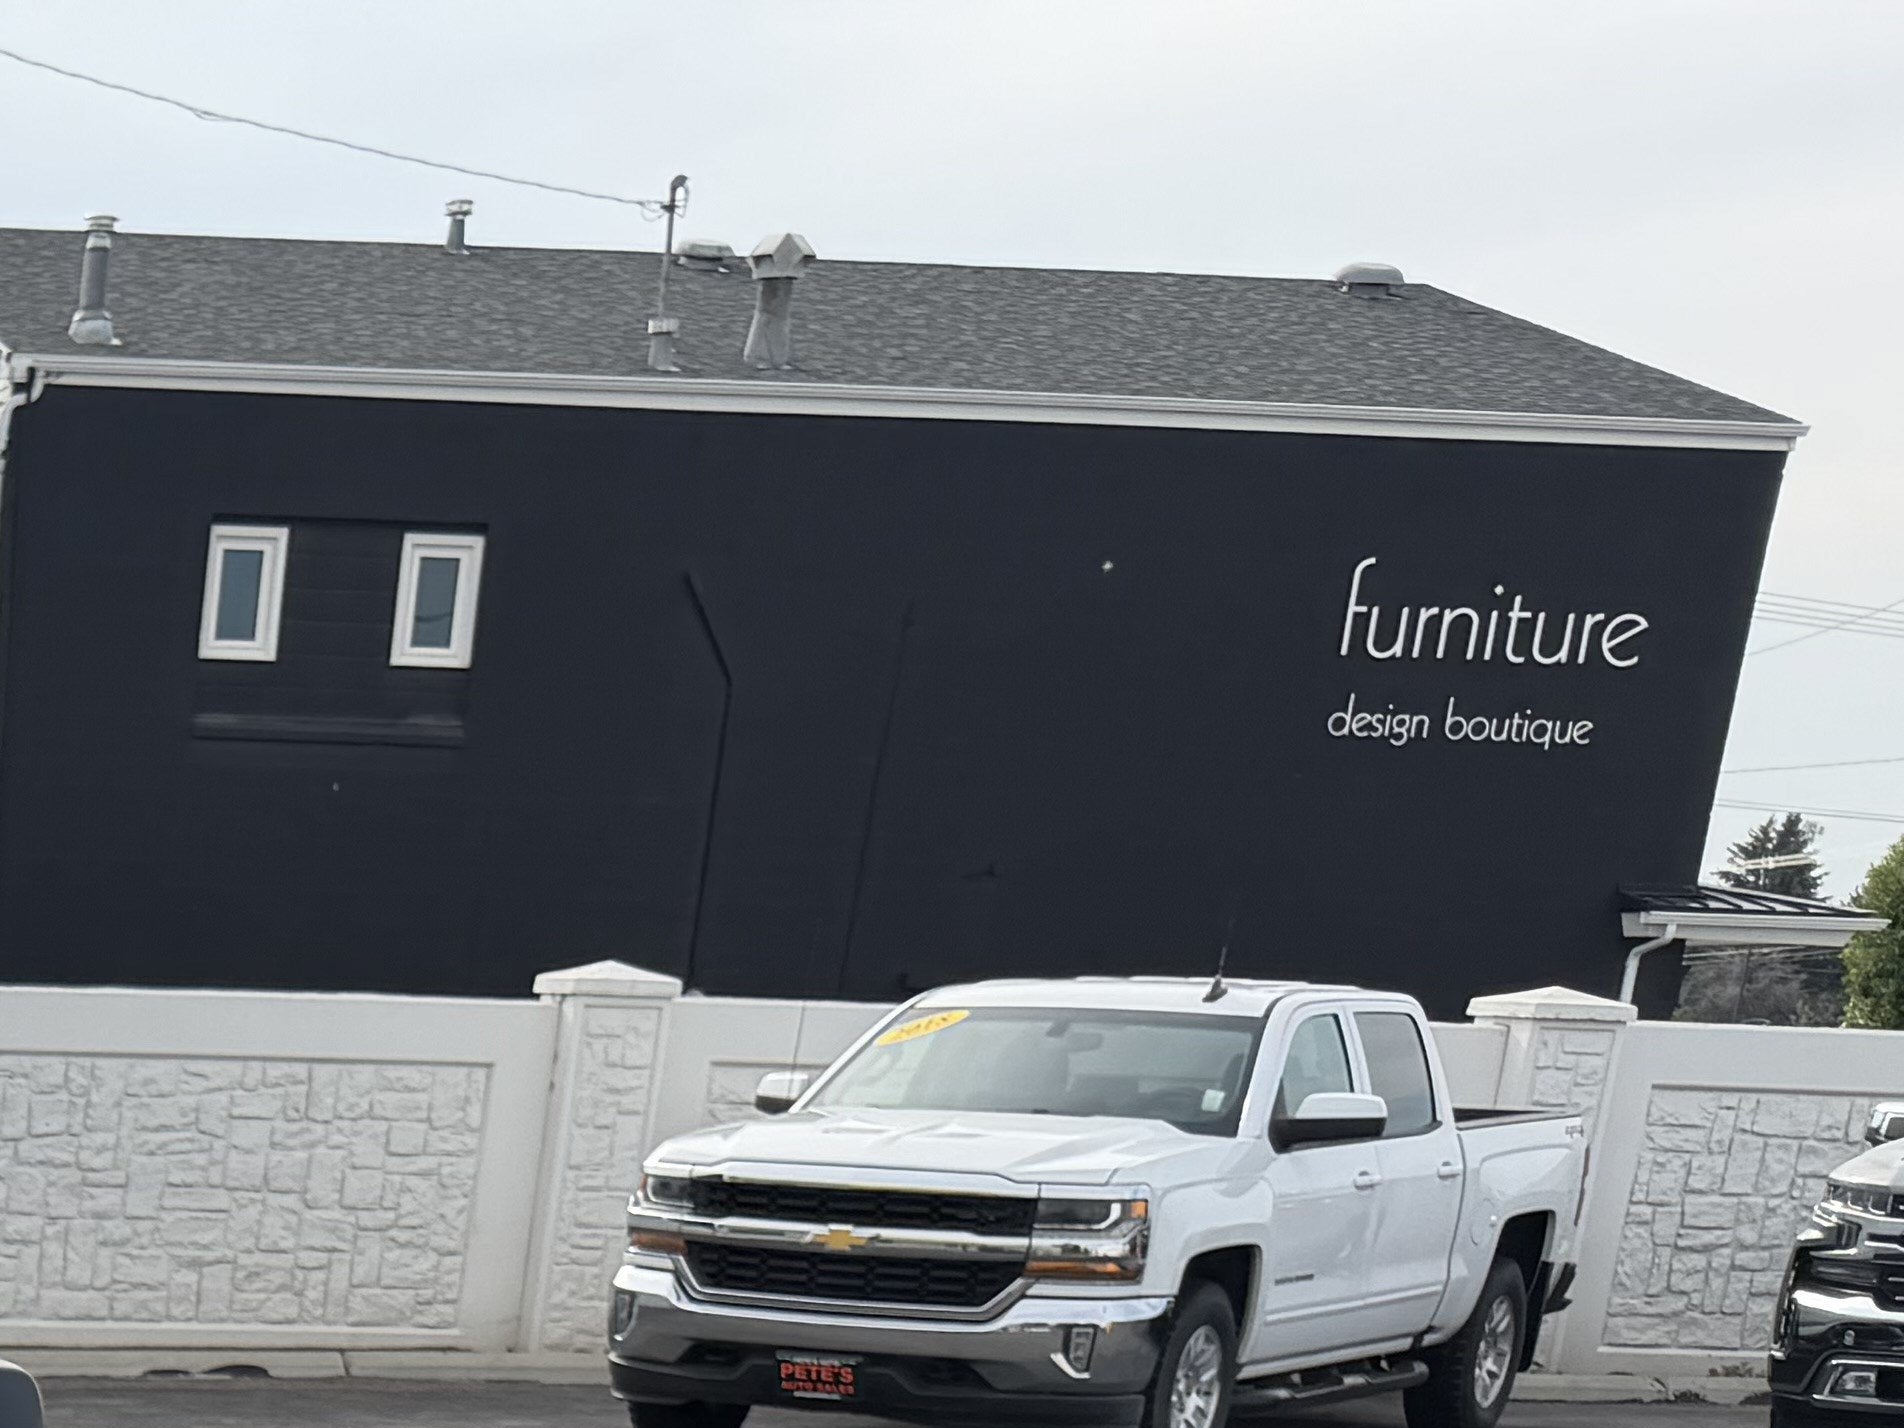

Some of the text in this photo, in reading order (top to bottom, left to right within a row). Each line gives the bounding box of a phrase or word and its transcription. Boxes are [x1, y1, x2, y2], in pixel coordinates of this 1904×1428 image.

[1339, 556, 1650, 668] furniture
[1327, 692, 1594, 751] design boutique
